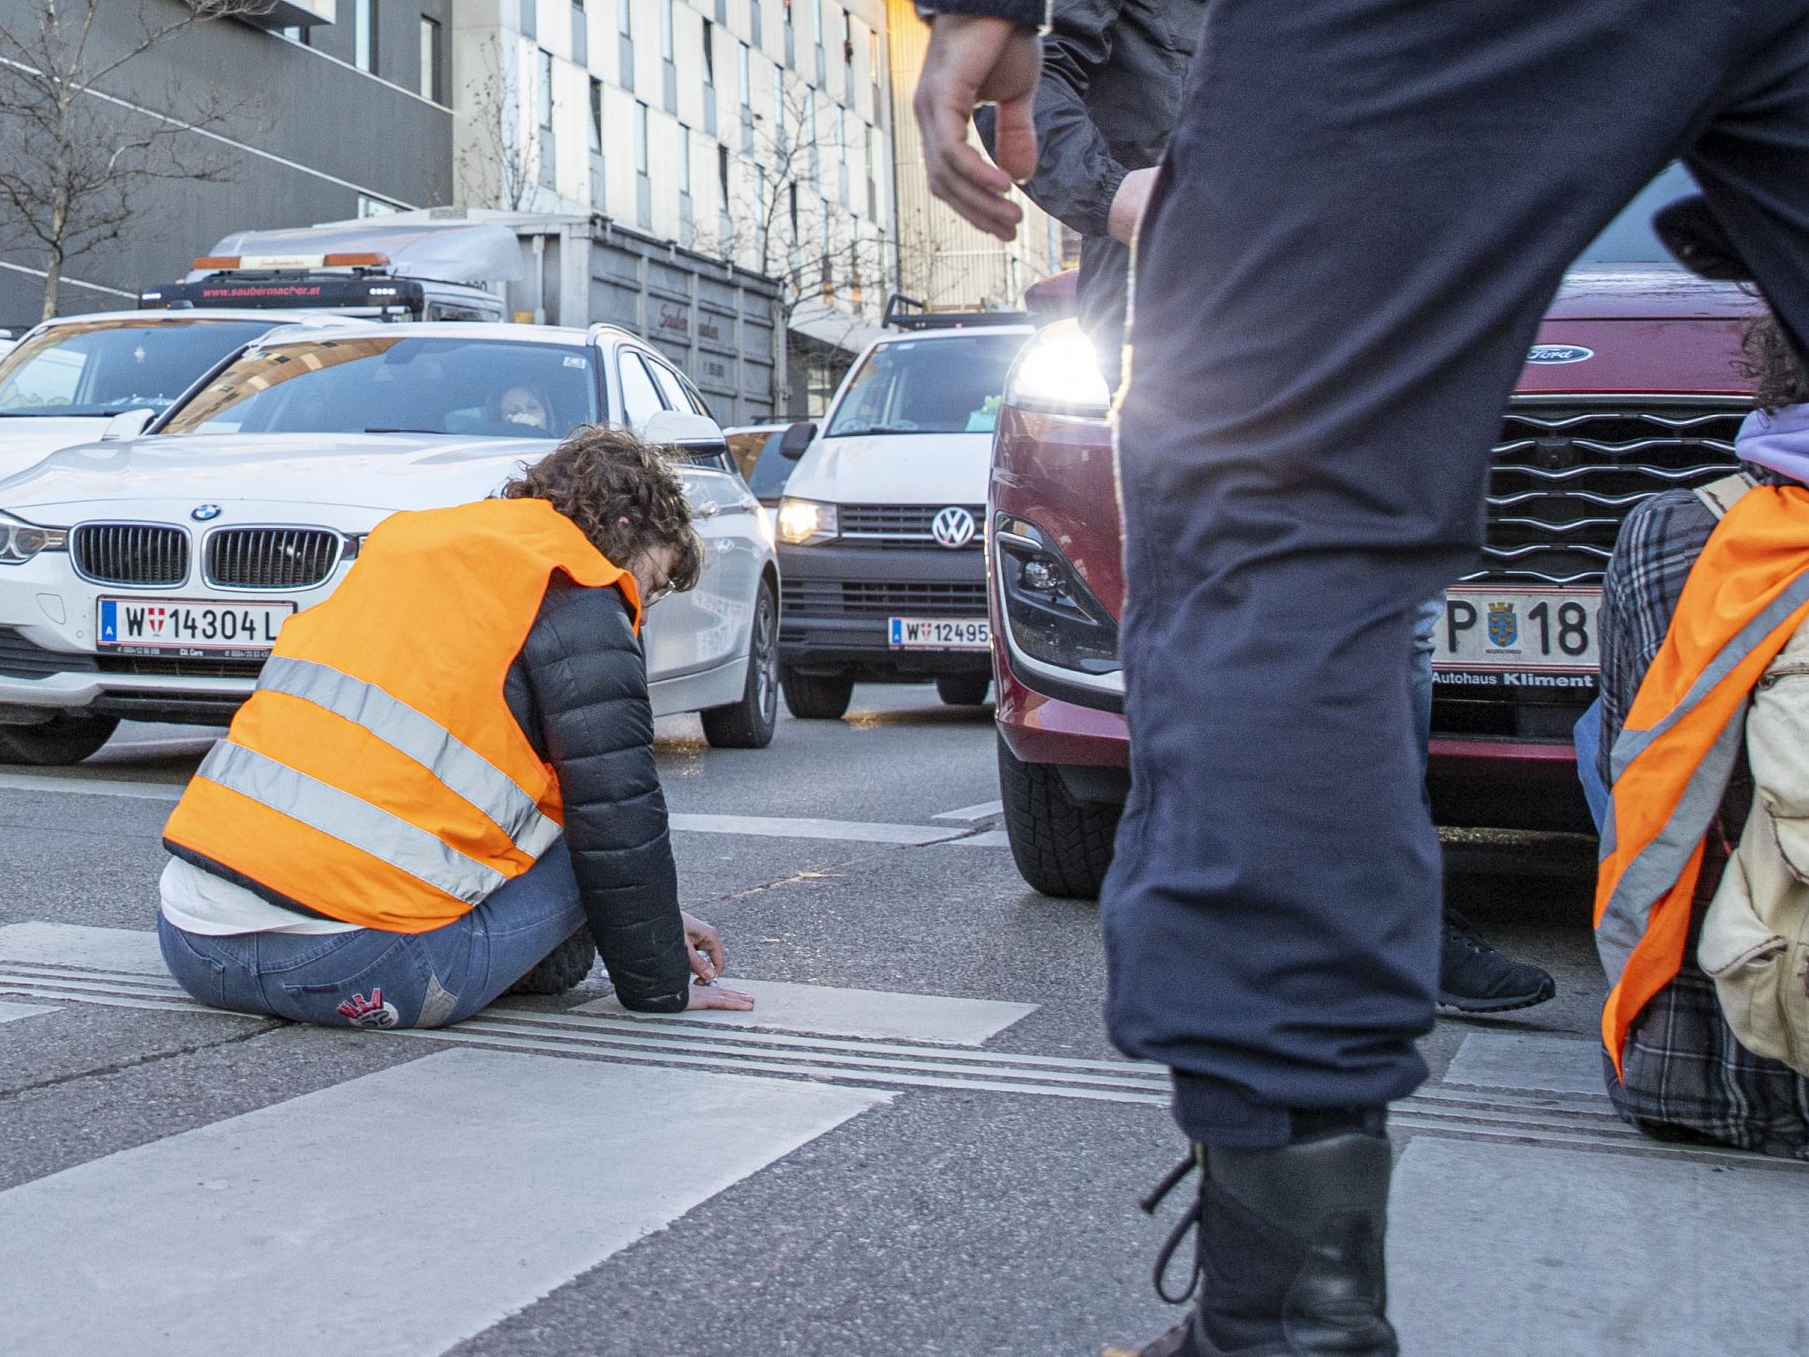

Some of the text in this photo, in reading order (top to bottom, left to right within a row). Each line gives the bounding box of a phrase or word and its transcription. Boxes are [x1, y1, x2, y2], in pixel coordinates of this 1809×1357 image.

[126, 607, 145, 636] W
[169, 609, 257, 640] 14304
[906, 624, 919, 641] W
[1431, 671, 1594, 687] Autohaus Kliment
